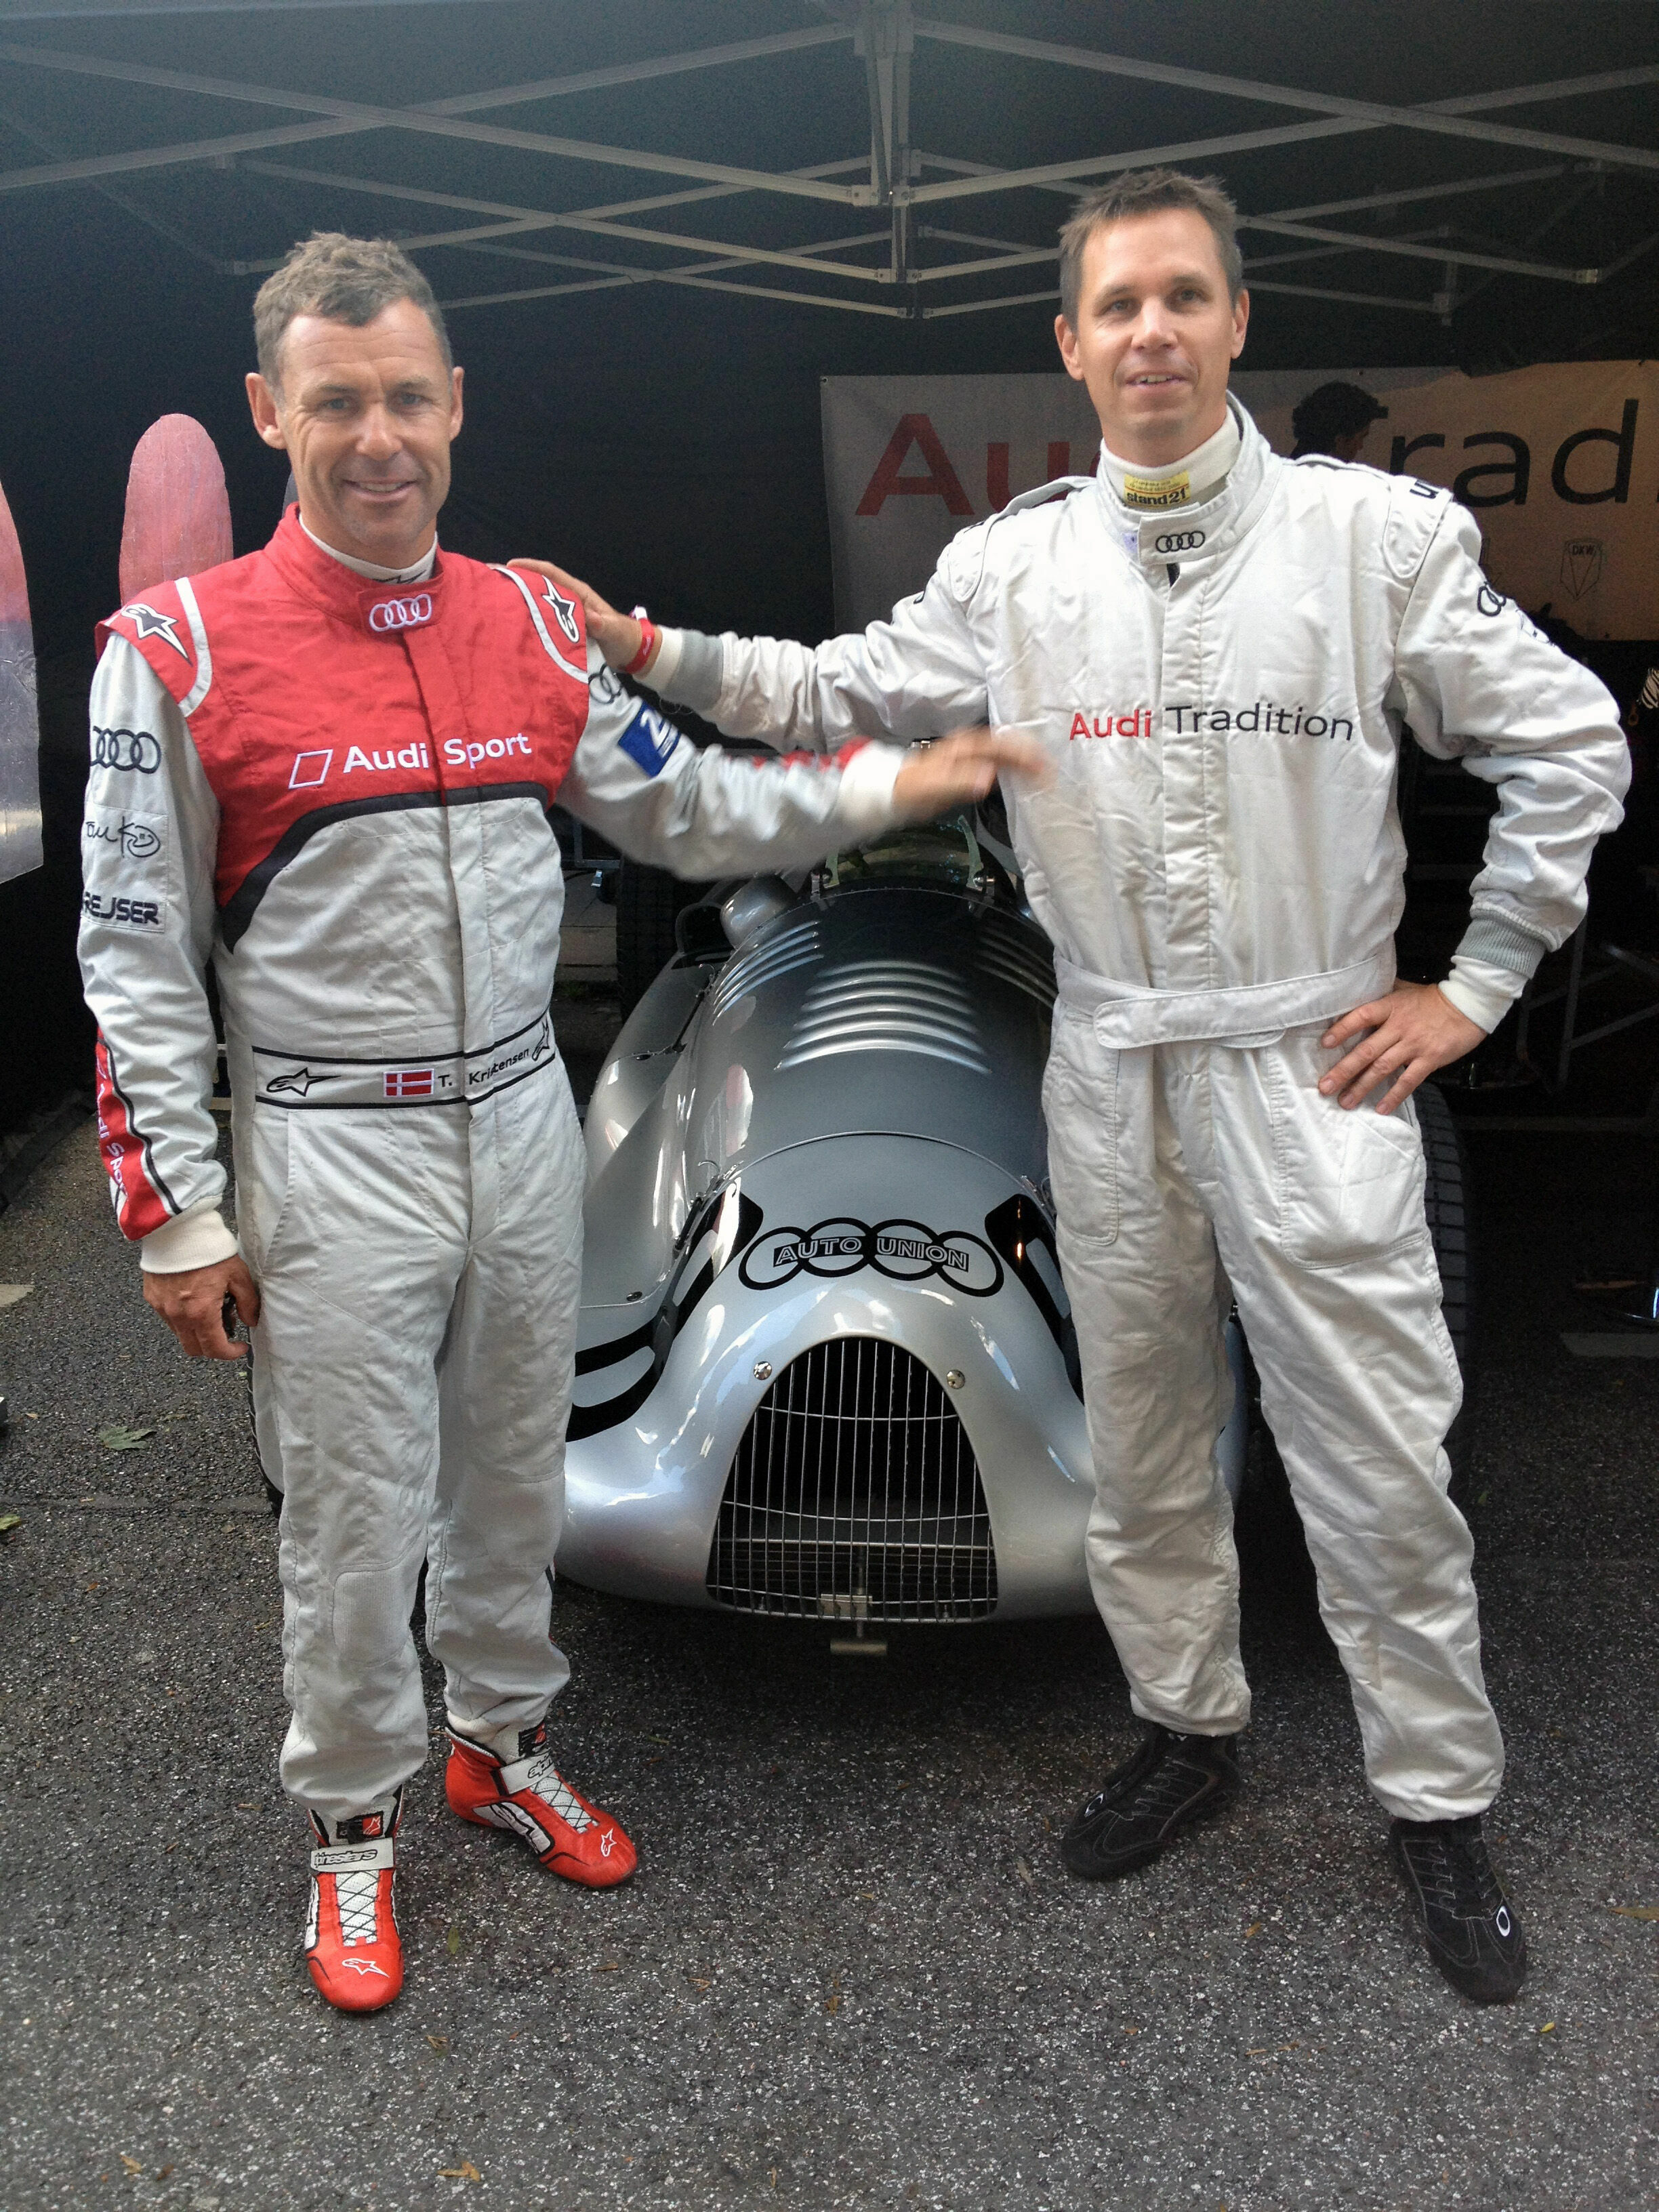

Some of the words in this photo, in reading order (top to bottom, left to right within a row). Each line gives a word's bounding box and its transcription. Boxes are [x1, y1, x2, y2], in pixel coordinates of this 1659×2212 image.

[855, 413, 1101, 515] Au
[1389, 398, 1640, 508] rad
[1069, 709, 1152, 741] Audi
[1165, 703, 1354, 741] Tradition
[343, 742, 429, 774] Audi
[443, 733, 532, 769] Sport
[438, 1074, 453, 1088] T.
[776, 1237, 862, 1266] AUTO
[876, 1237, 969, 1269] UNION
